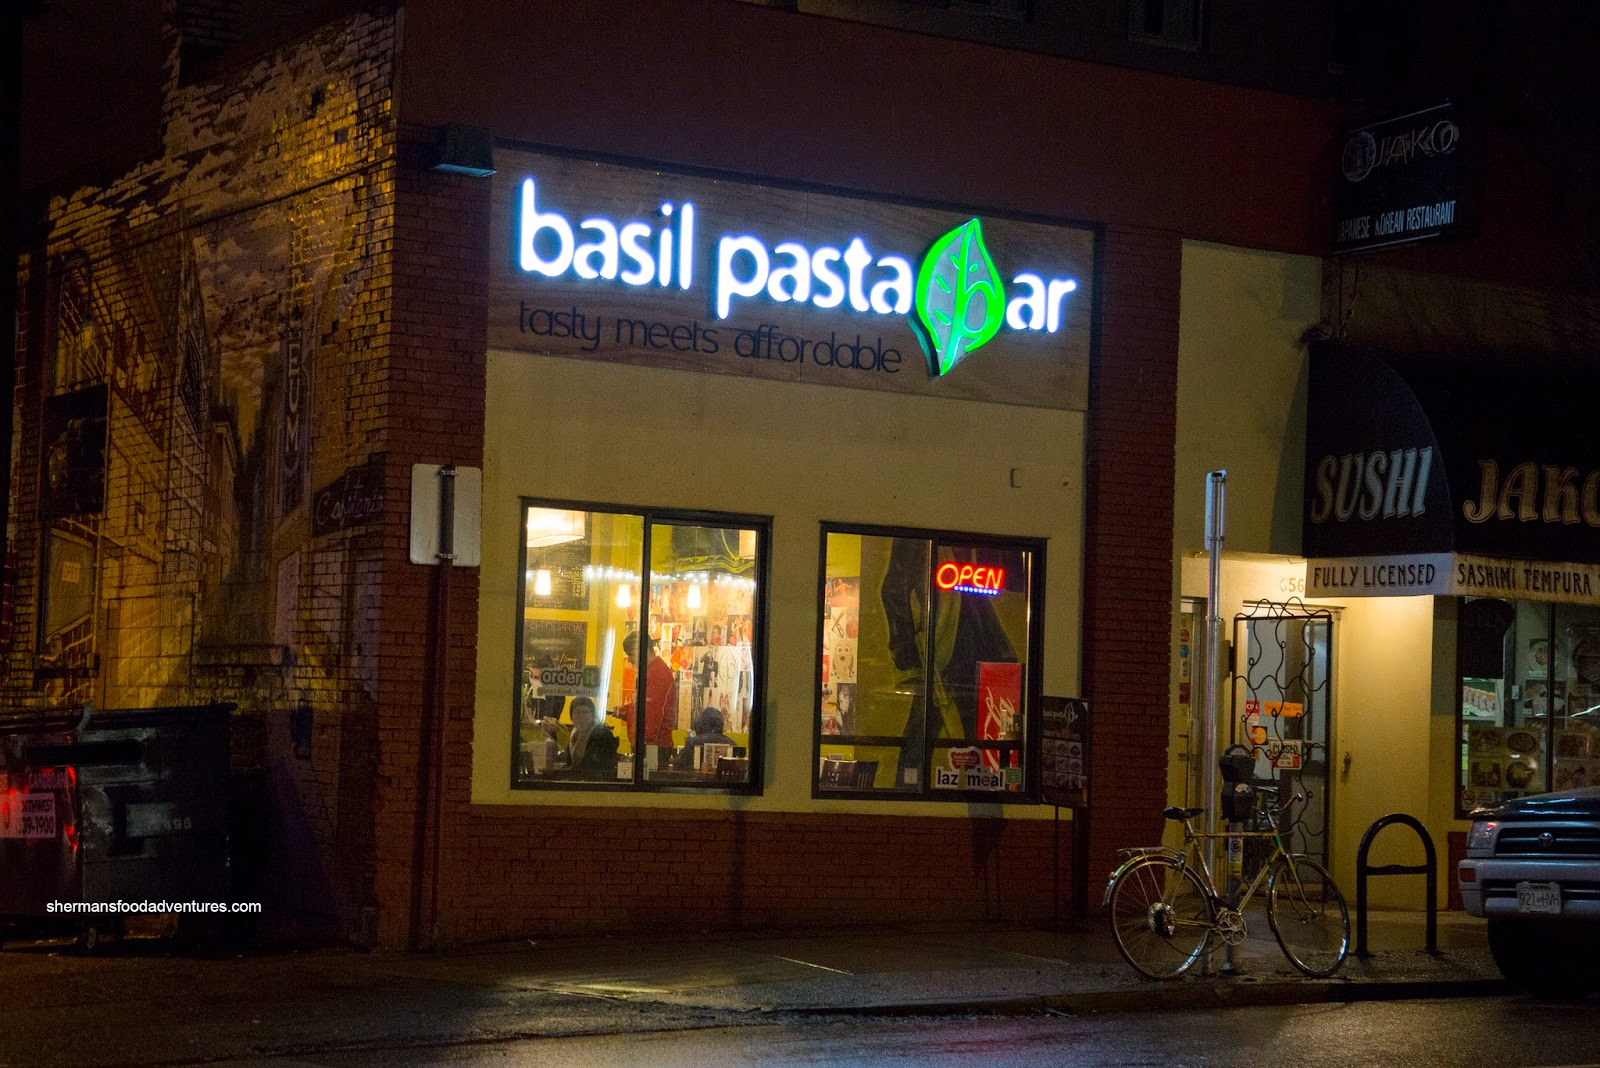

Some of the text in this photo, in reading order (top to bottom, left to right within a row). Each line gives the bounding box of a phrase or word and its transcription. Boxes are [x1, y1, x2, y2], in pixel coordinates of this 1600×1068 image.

[1371, 120, 1460, 168] JAKO
[1375, 209, 1405, 237] KOREAN
[1406, 199, 1457, 230] RESTAURANT
[518, 176, 695, 290] basil
[714, 231, 913, 321] pasta
[519, 300, 902, 375] tasty meets affordable
[1310, 445, 1434, 523] SUSHI
[935, 562, 1004, 590] OPEN
[1314, 564, 1436, 587] FULLY LICENSED
[1457, 563, 1593, 597] SASHIMI TEMPURA
[541, 667, 583, 686] order
